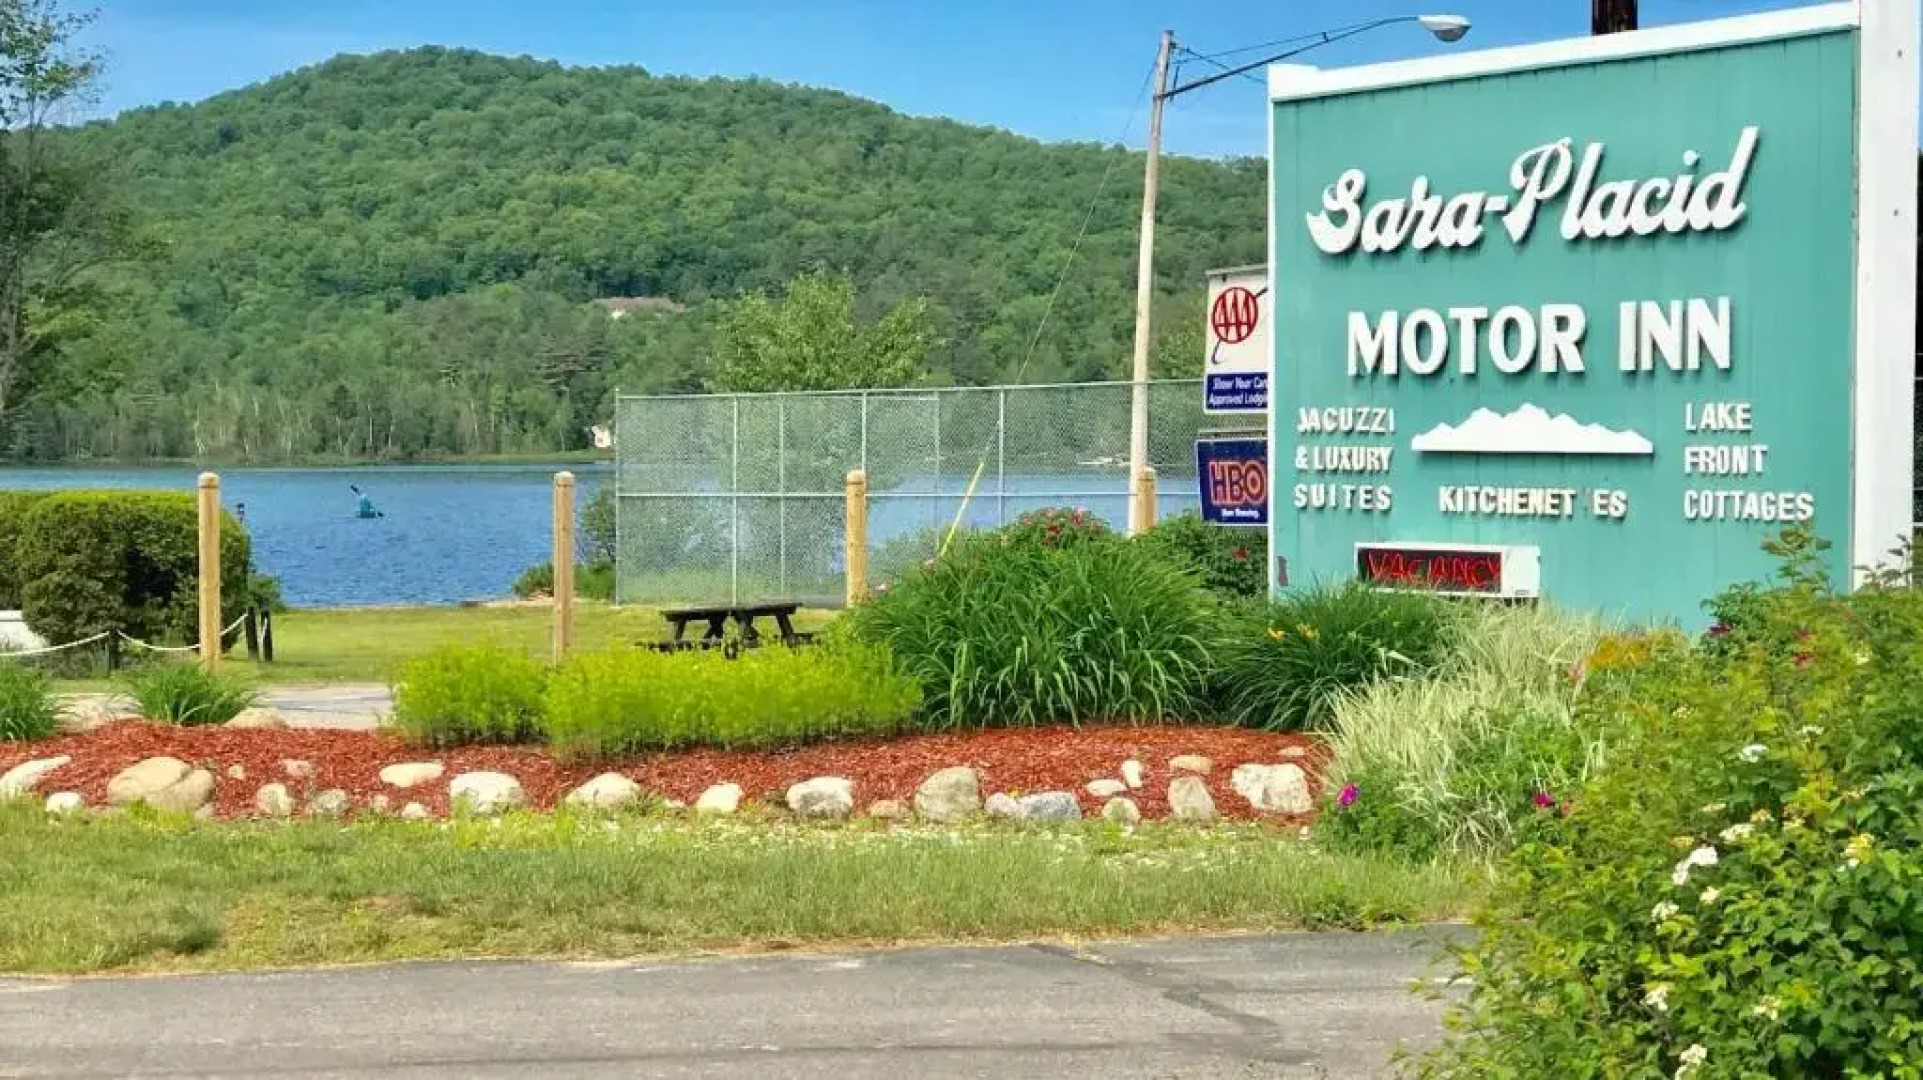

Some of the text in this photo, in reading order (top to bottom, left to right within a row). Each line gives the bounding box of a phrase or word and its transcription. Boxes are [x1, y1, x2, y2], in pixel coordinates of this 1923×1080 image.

[1306, 126, 1758, 254] Sara-Placid
[1213, 287, 1256, 343] AAA
[1347, 297, 1731, 376] MOTOR INN
[1297, 406, 1396, 433] JACUZZI
[1684, 401, 1753, 431] LAKE
[1294, 444, 1394, 472] & LUXURY
[1683, 443, 1768, 475] FRONT
[1208, 461, 1267, 506] HBO
[1293, 482, 1393, 511] SUITES
[1683, 488, 1816, 521] COTTAGES
[1367, 549, 1500, 588] VACANCY
